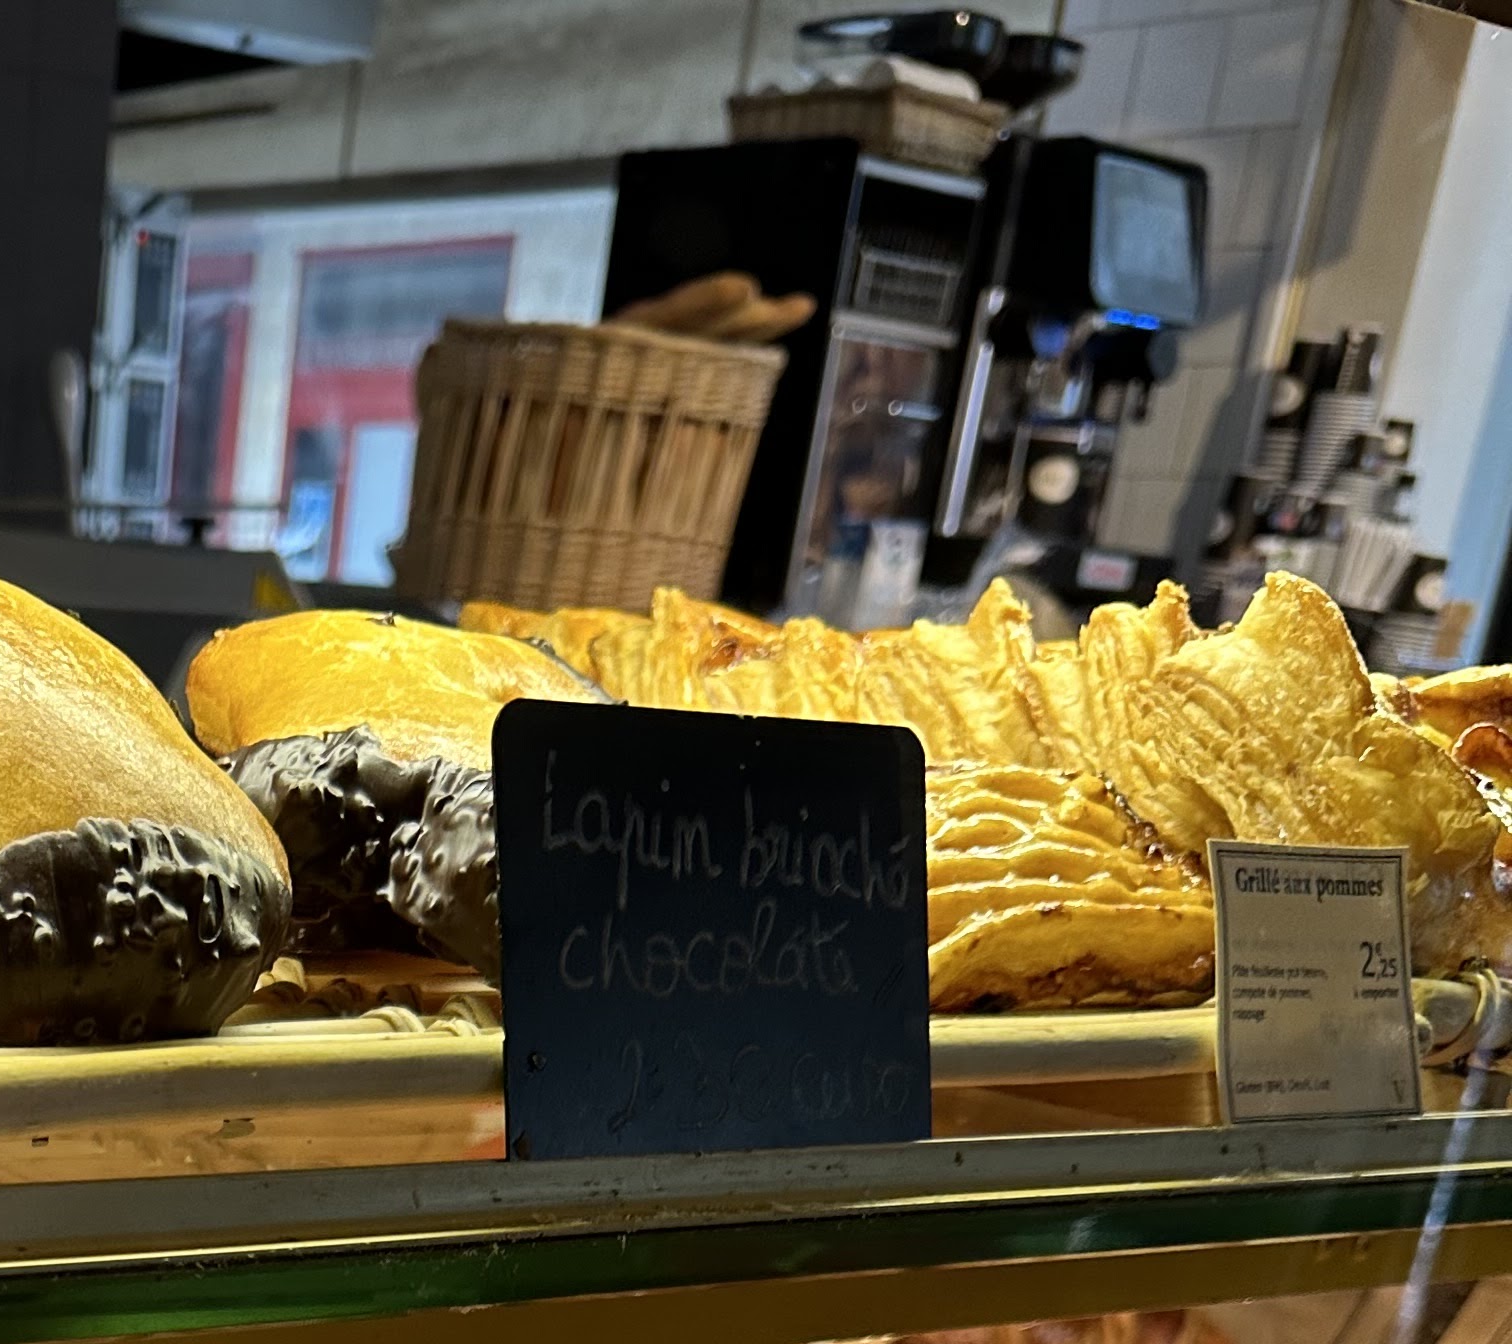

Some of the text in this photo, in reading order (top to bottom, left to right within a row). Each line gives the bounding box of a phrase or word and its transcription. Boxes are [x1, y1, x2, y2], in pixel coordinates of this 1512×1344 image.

[1235, 866, 1384, 903] Grillé aux pommes
